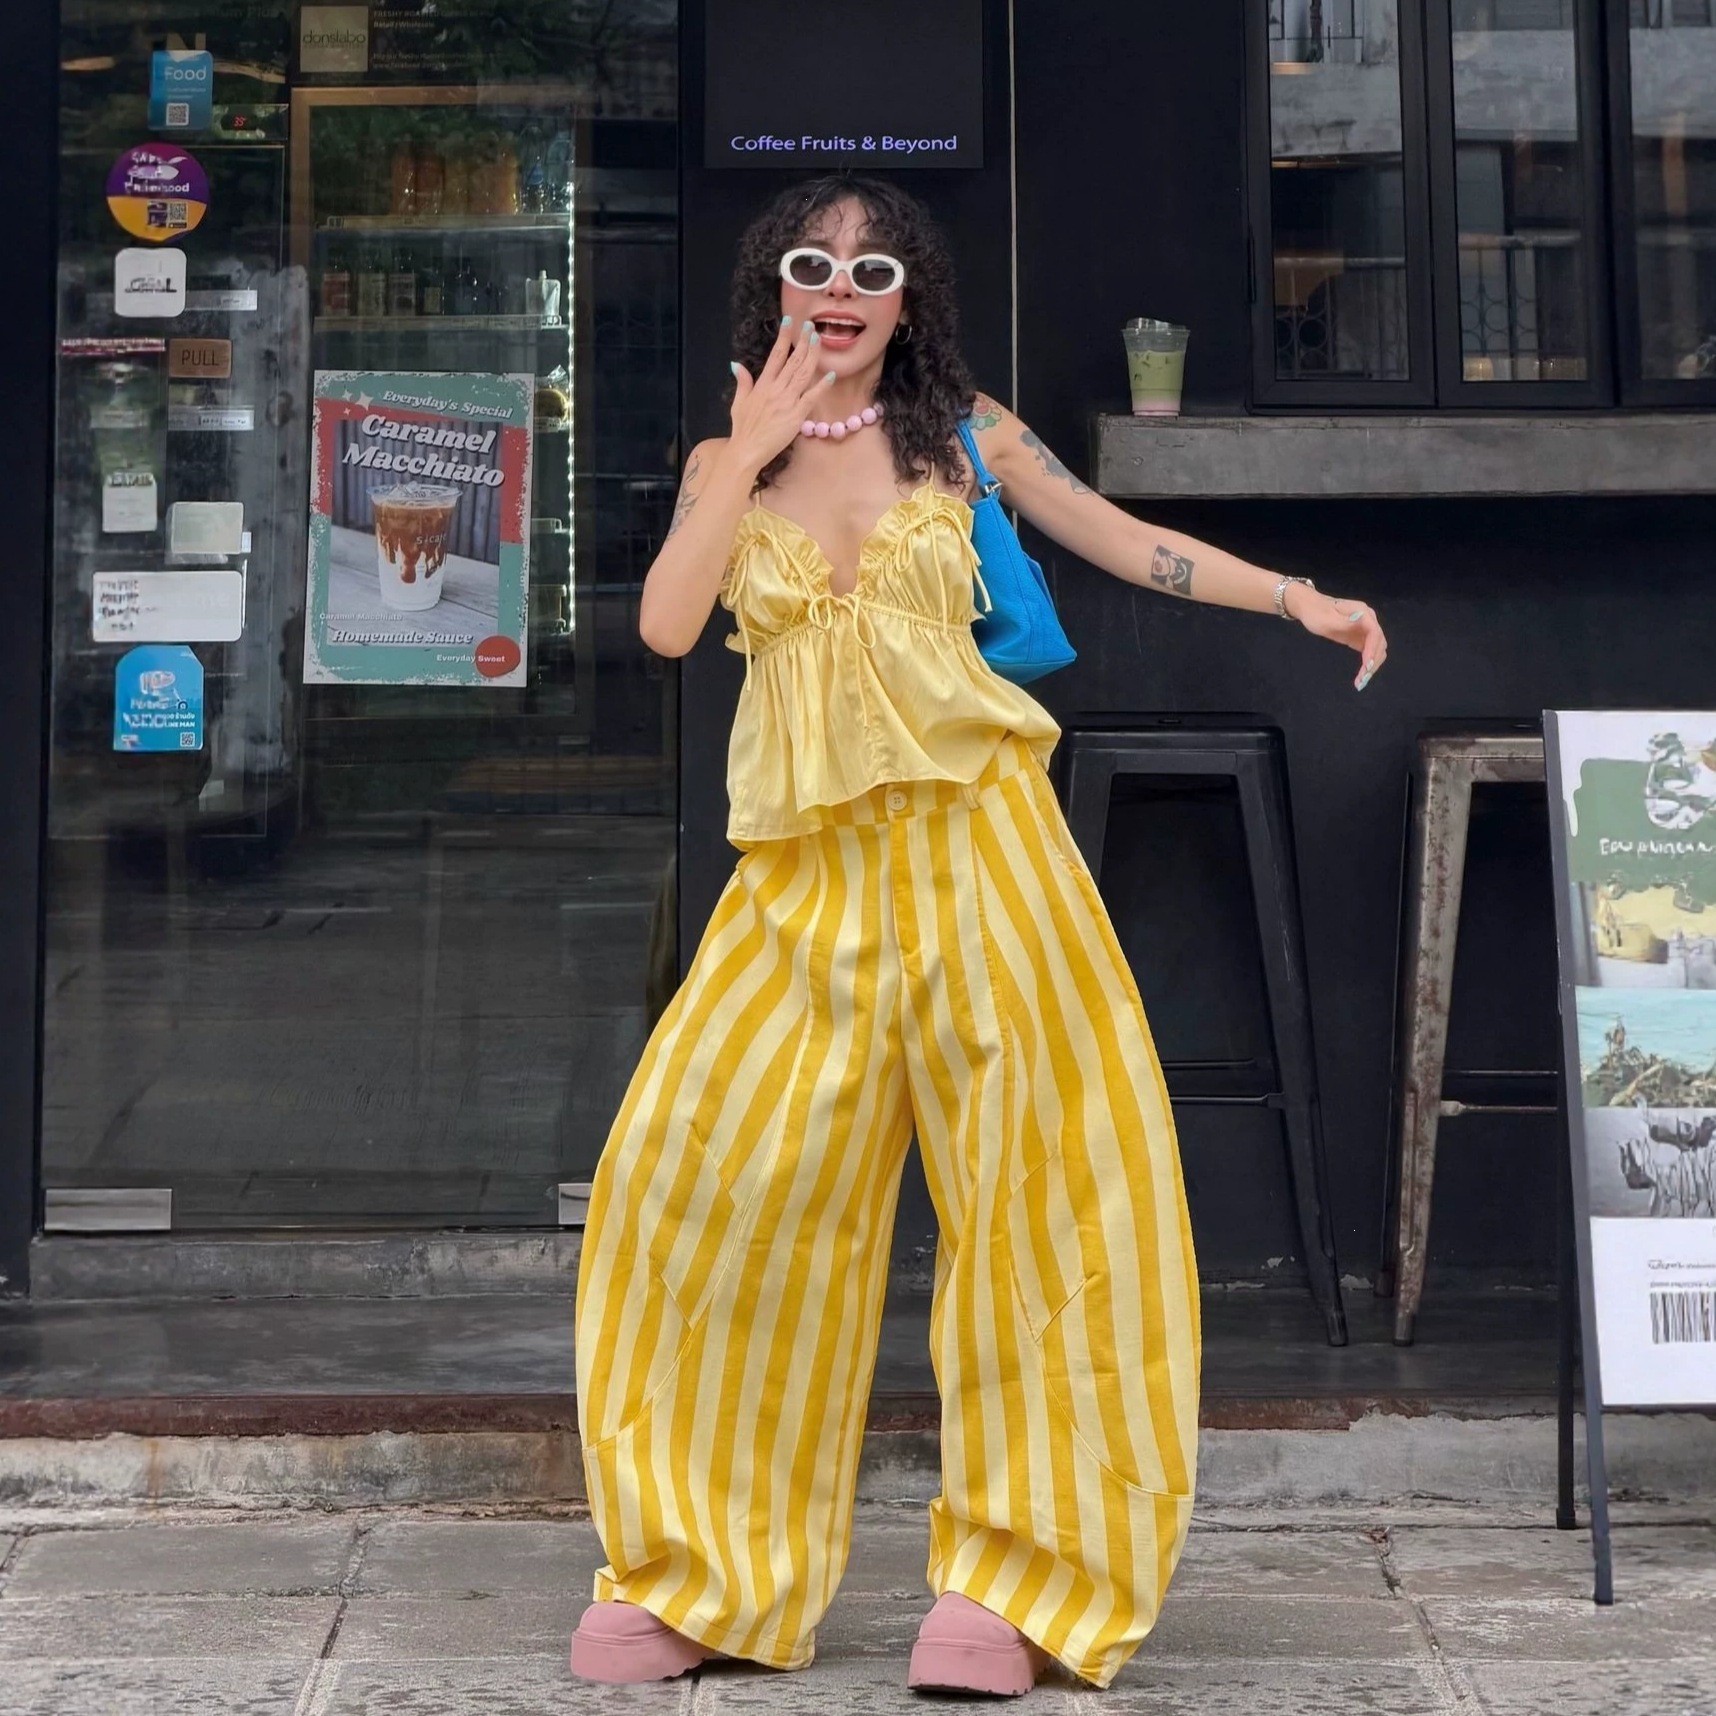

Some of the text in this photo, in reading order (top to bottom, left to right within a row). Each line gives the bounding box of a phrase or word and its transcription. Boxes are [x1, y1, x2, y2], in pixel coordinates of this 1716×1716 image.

[164, 65, 207, 81] Food
[731, 135, 958, 155] Coffee Fruits & Beyond
[181, 349, 220, 366] PULL
[383, 390, 513, 419] Everyday's Special
[361, 414, 497, 454] Caramel
[342, 442, 505, 487] Macchiato
[332, 630, 474, 644] Homemade Sauce
[436, 653, 506, 664] Everyday Sweet
